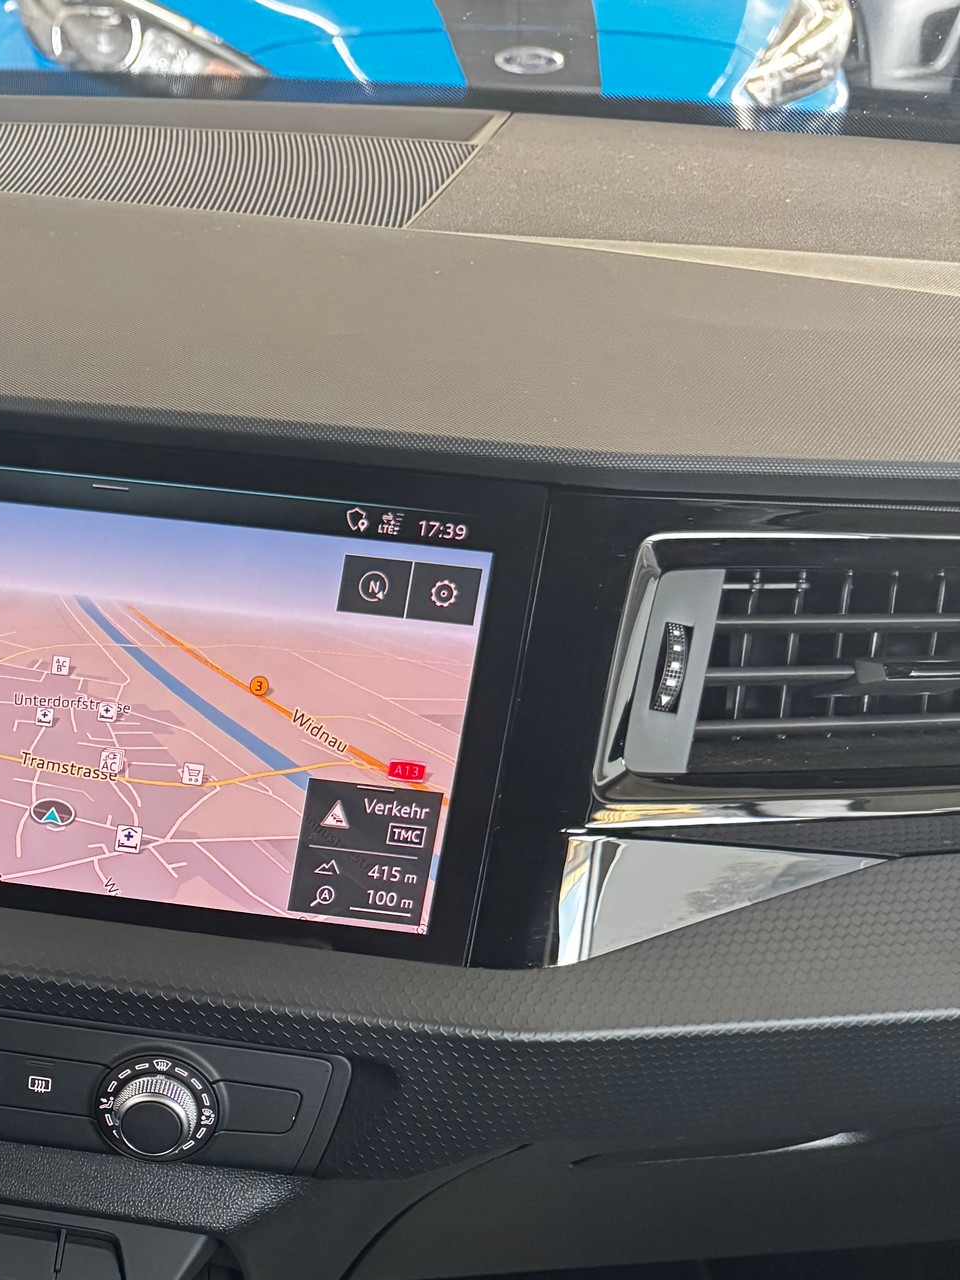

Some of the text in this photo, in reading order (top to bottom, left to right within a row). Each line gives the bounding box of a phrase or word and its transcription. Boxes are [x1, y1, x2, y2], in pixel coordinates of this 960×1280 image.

[378, 524, 394, 535] LTE
[419, 520, 467, 540] 17:39
[254, 681, 264, 692] 3
[14, 693, 131, 715] Unterdorfstrse
[292, 709, 349, 754] Widnau
[393, 764, 420, 778] A13
[364, 798, 430, 820] Verkehr
[392, 828, 422, 843] TMC
[367, 865, 417, 884] 415 m
[366, 889, 413, 909] 100 m
